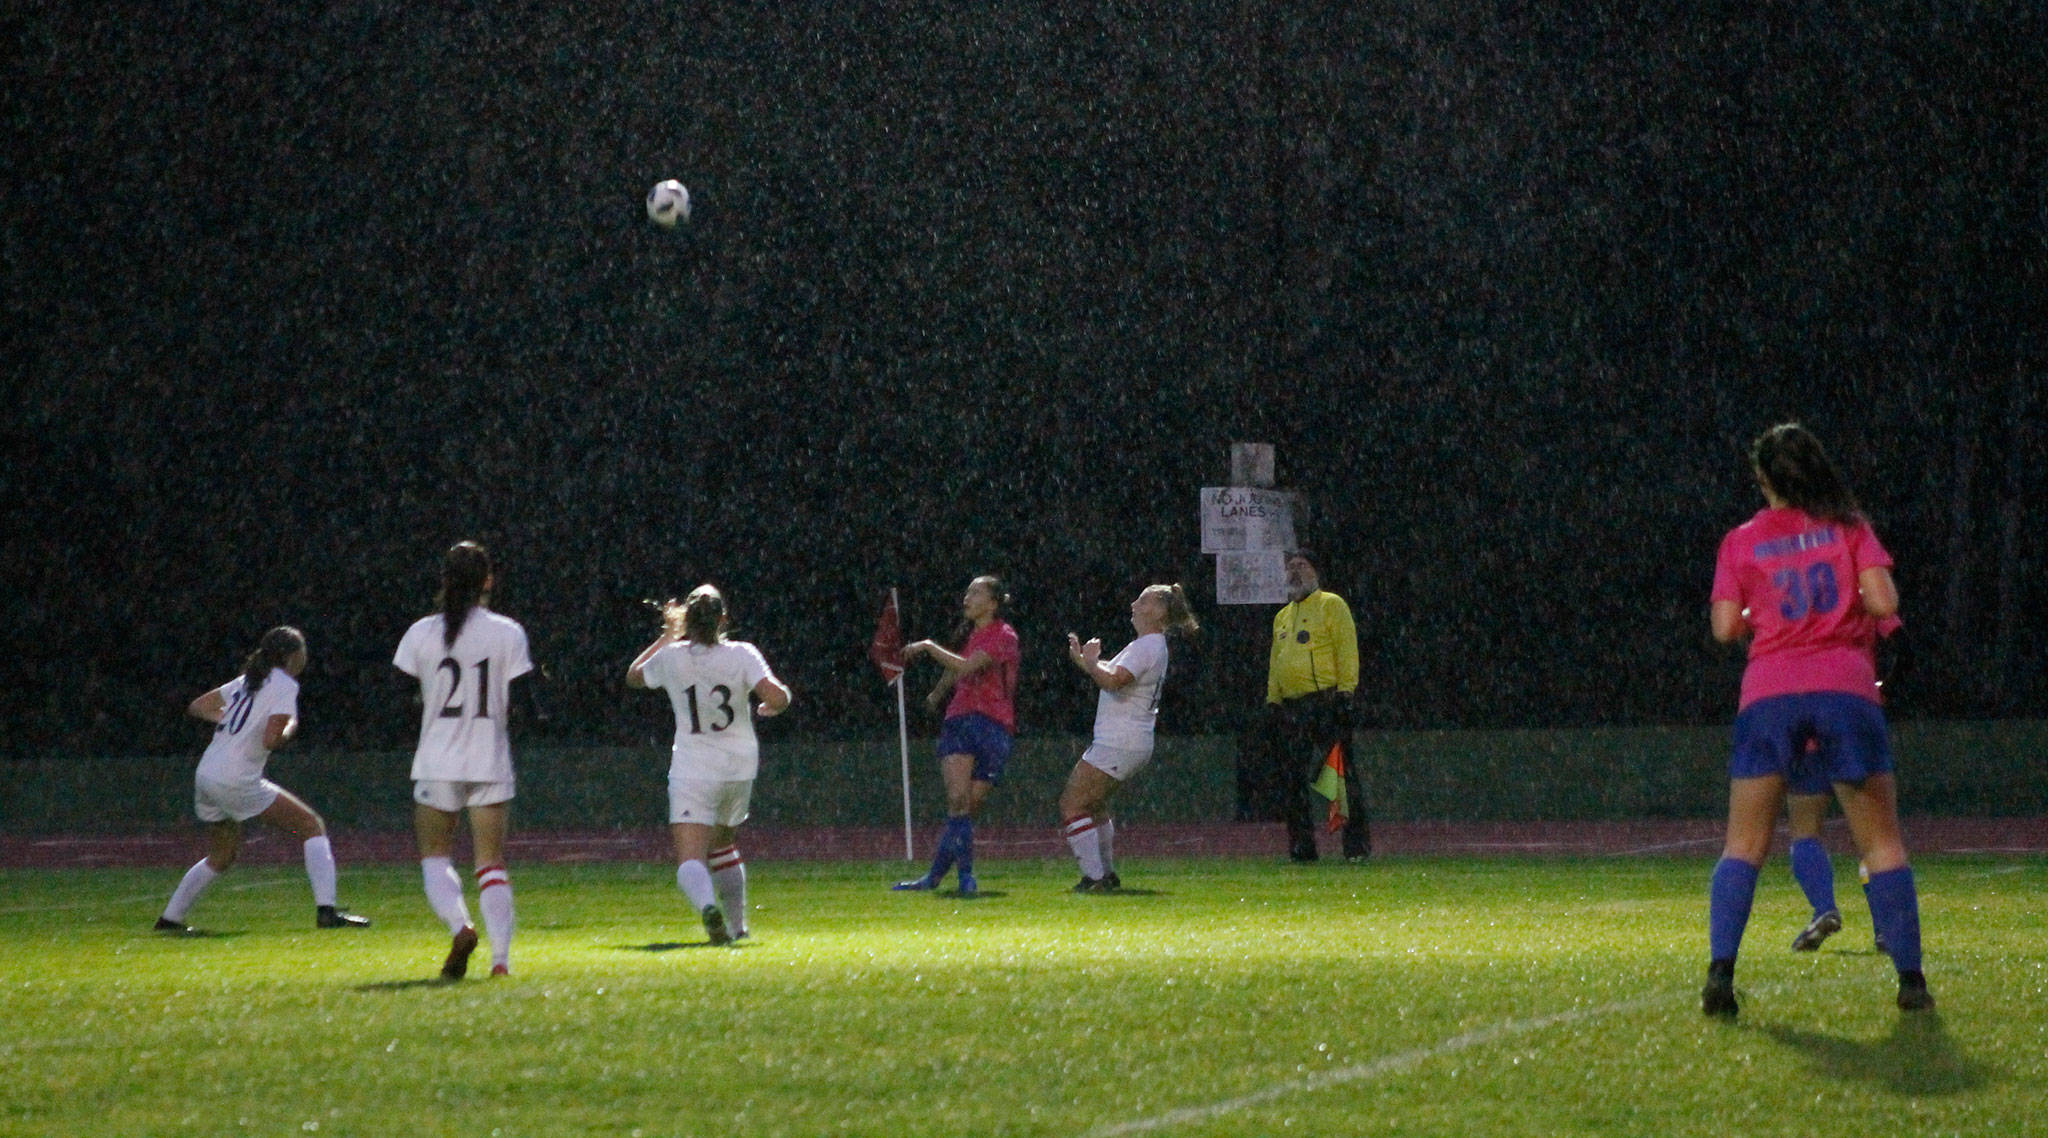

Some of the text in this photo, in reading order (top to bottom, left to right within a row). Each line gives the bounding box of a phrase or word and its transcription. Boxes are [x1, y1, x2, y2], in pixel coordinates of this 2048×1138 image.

[1221, 506, 1266, 518] LANES
[435, 657, 489, 719] 21
[682, 684, 735, 735] 13
[216, 690, 254, 735] 20
